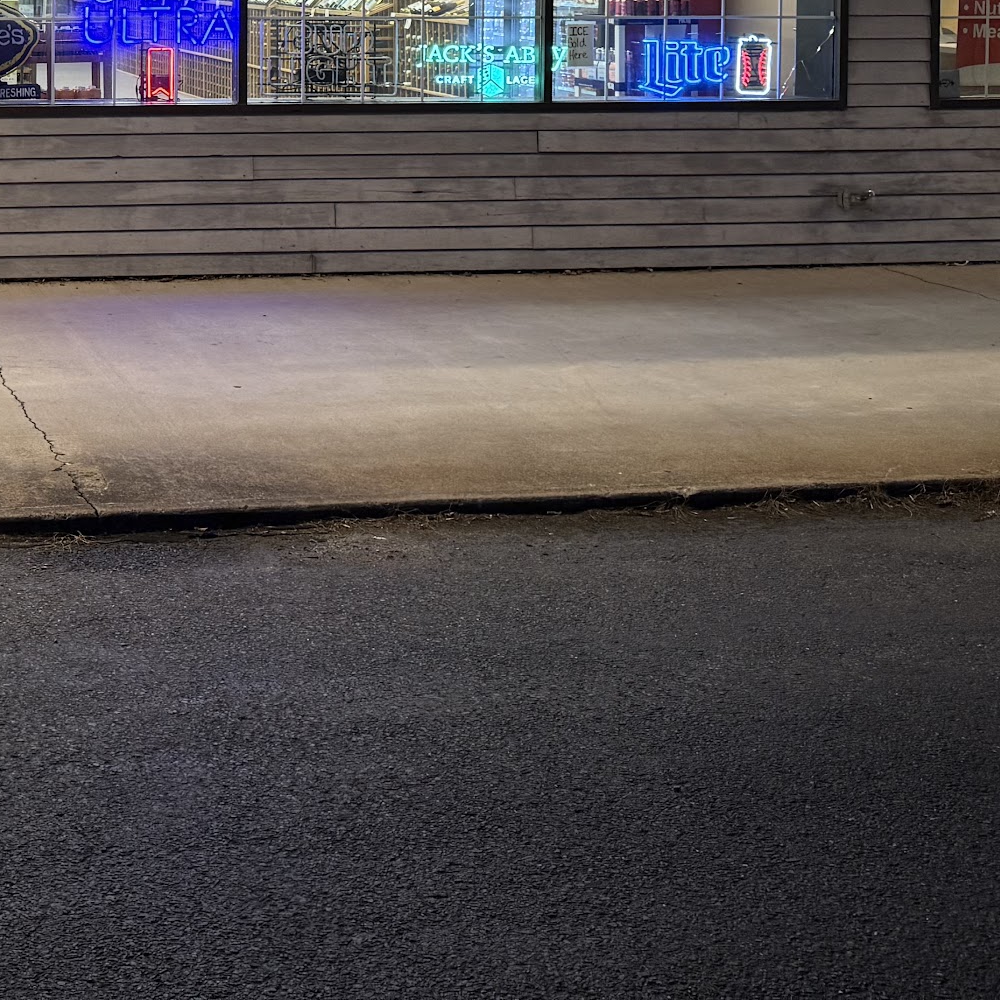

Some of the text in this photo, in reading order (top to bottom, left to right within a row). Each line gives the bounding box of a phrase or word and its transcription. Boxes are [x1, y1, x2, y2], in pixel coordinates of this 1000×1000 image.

[84, 6, 234, 45] ULTRA
[569, 26, 589, 36] ICE
[568, 36, 587, 48] Sold
[416, 44, 495, 67] JACK'S
[569, 51, 588, 60] Here
[637, 39, 731, 97] Lite
[435, 75, 540, 85] CRAFT LAGE
